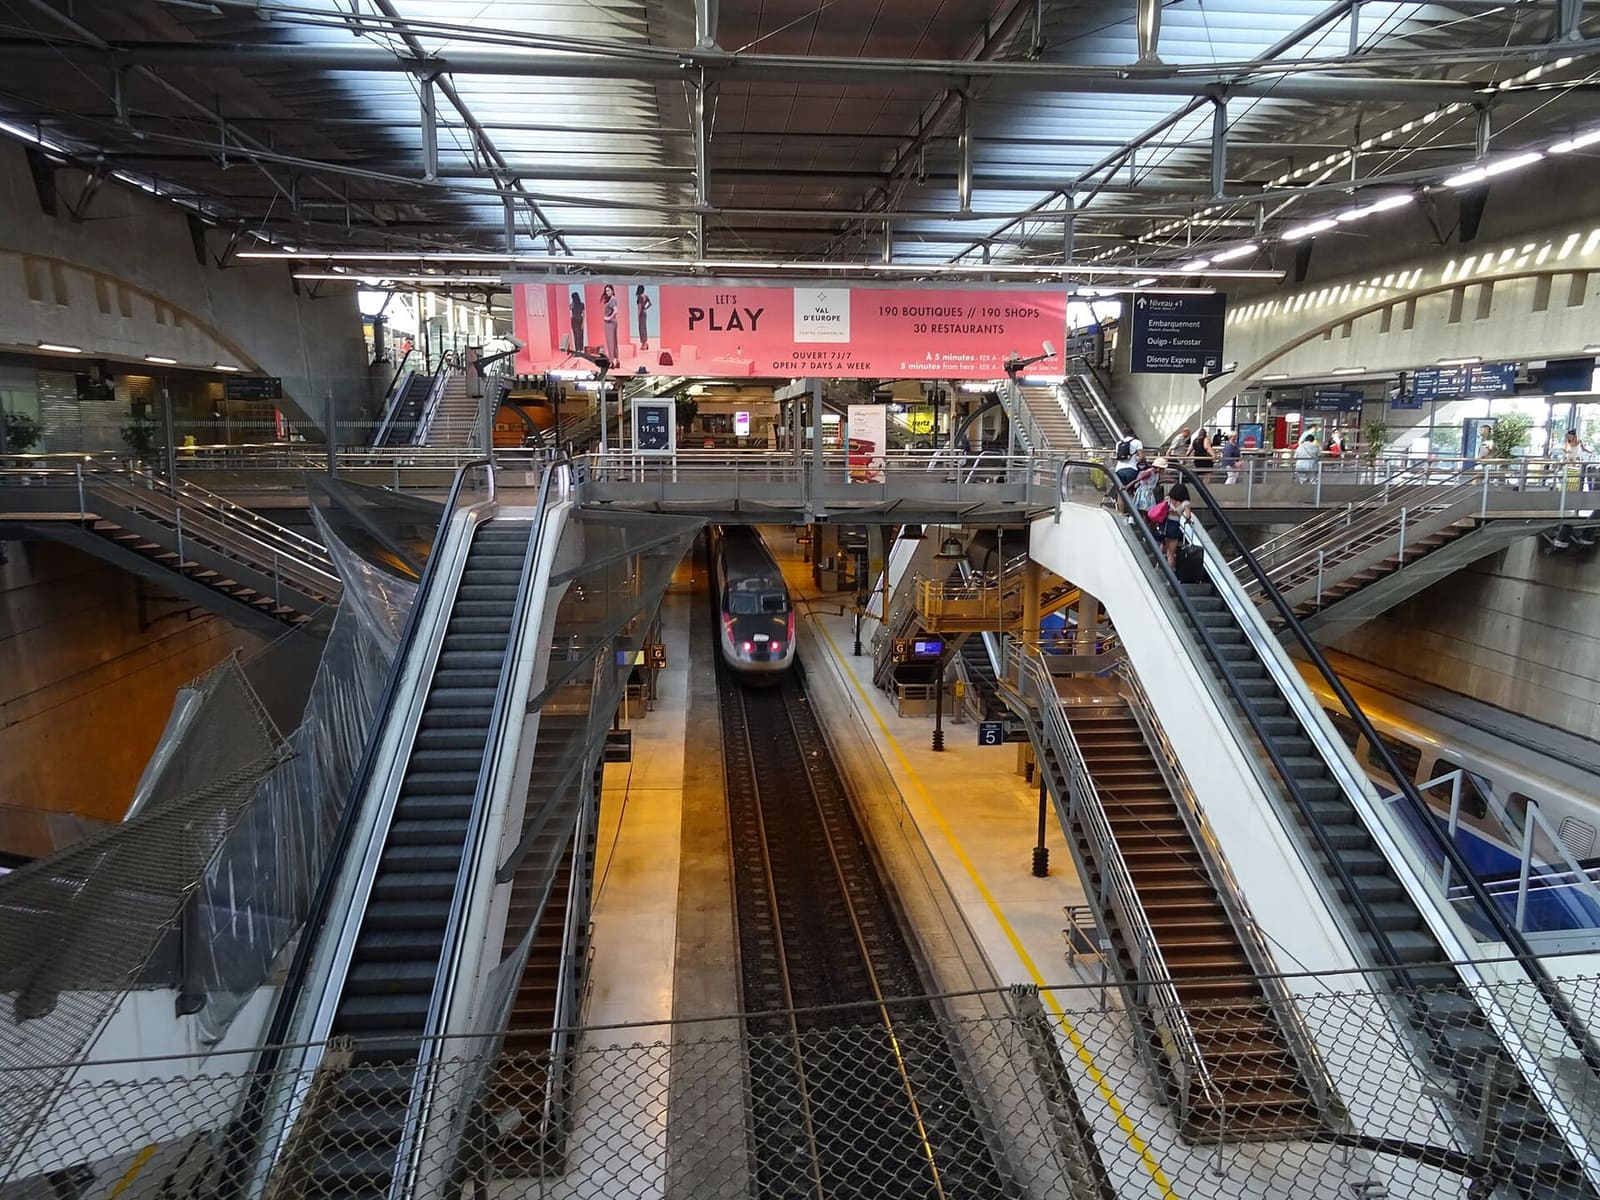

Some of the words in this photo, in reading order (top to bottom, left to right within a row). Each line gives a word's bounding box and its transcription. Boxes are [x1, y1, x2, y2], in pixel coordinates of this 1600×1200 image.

[715, 294, 738, 305] LET'S
[879, 306, 898, 317] 190
[902, 306, 963, 318] BOUTIQUES
[982, 307, 1001, 318] 190
[1005, 307, 1040, 318] SHOPS
[688, 307, 765, 331] PLAY
[1148, 319, 1201, 328] Embarquement
[913, 323, 928, 334] 30
[931, 323, 1004, 334] RESTAURANTS
[1172, 338, 1201, 346] Eurostar
[792, 351, 827, 360] OUVERT
[925, 352, 932, 361] À
[942, 353, 975, 361] minutes
[1147, 355, 1169, 364] Disney
[1170, 356, 1196, 364] Express
[900, 362, 906, 370] 5
[908, 362, 940, 370] minutes
[942, 362, 957, 370] from
[959, 362, 974, 371] here
[896, 644, 904, 652] G
[985, 730, 996, 744] 5
